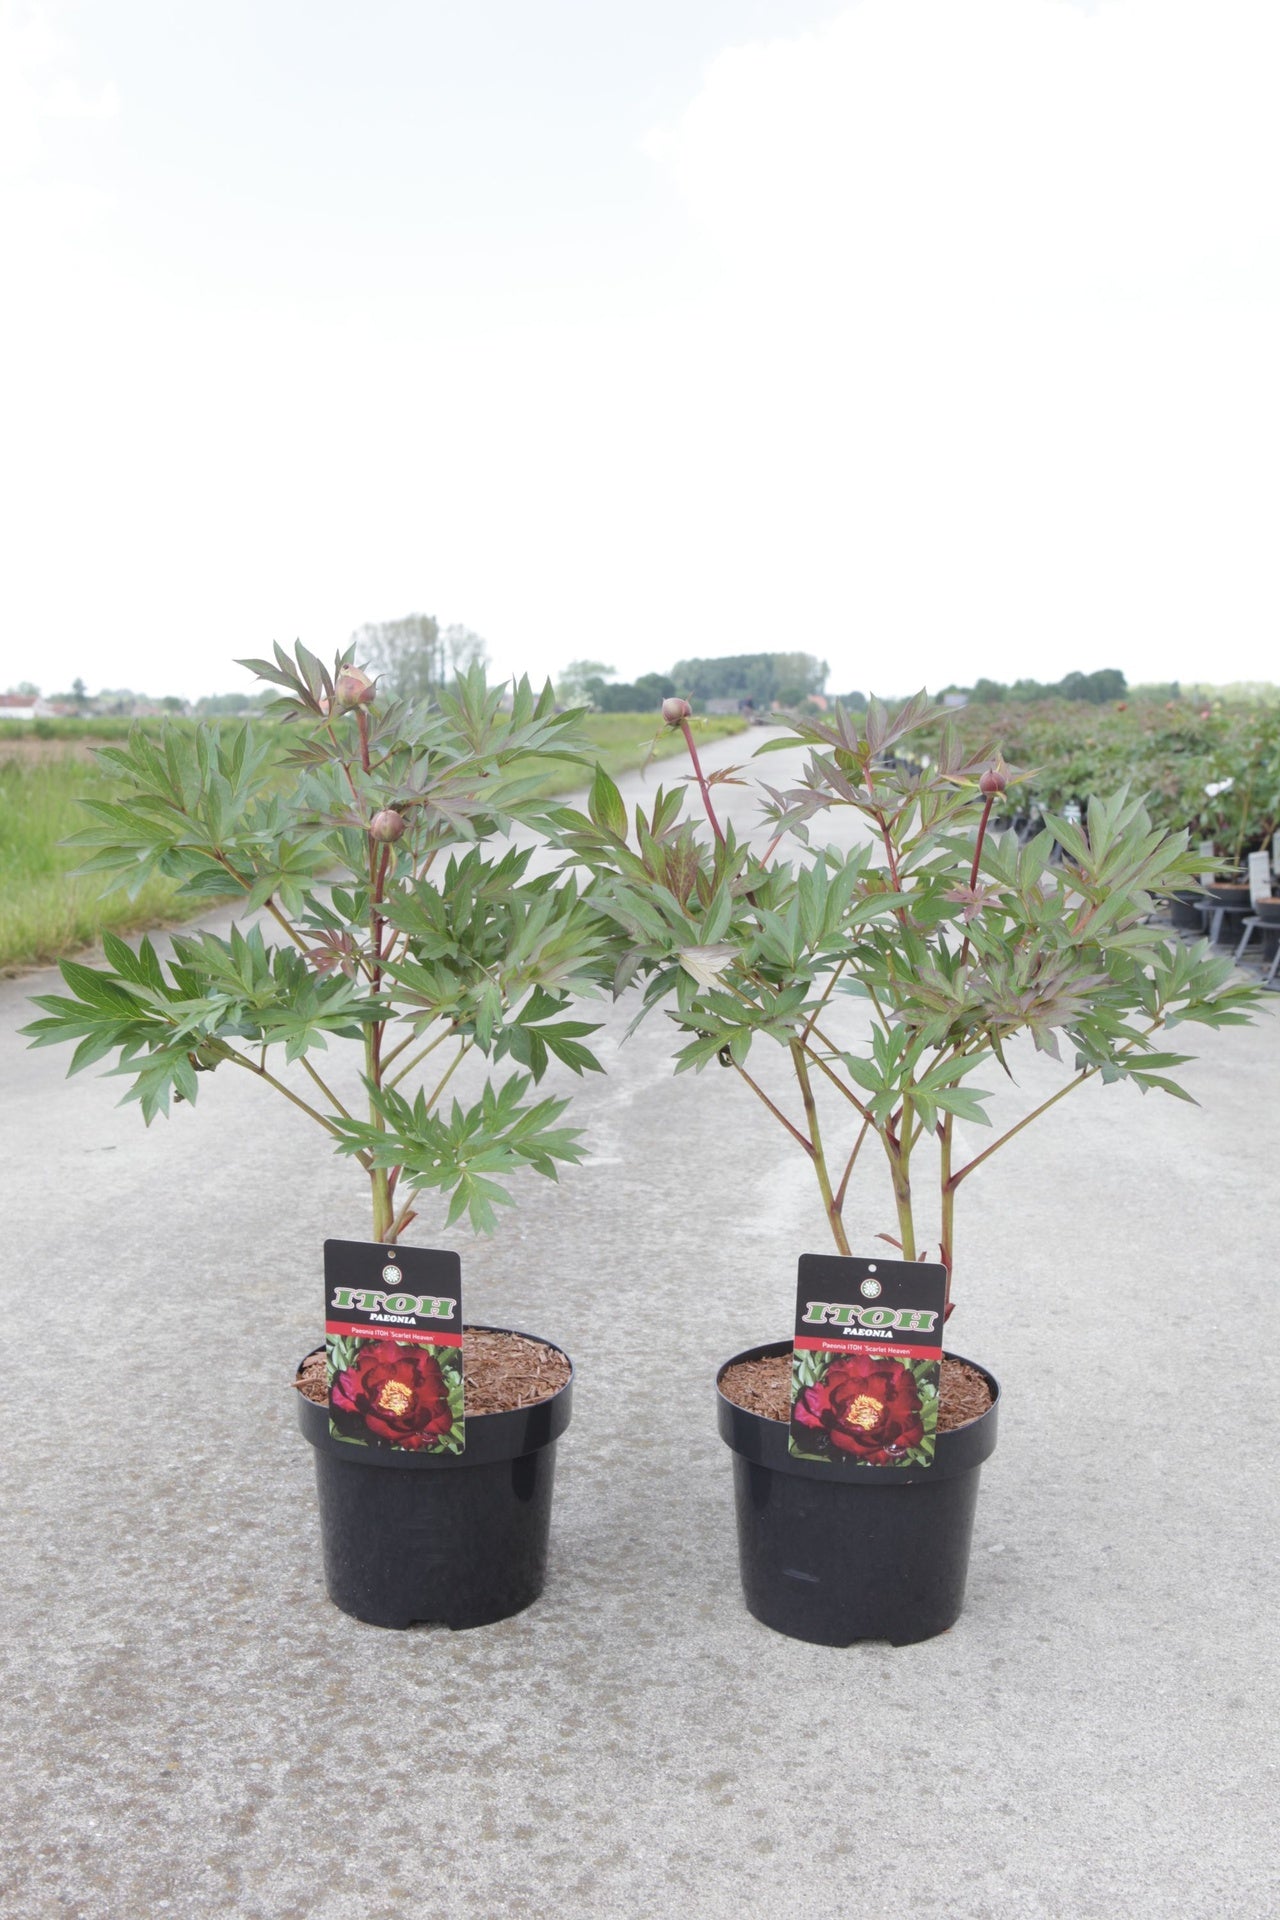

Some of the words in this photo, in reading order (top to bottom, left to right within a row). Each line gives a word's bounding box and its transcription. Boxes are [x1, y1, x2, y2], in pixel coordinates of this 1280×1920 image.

[331, 1287, 457, 1319] ITOH
[369, 1313, 416, 1325] PAEONIA
[802, 1302, 939, 1332] ITOH
[351, 1326, 374, 1336] Paeonia
[374, 1329, 389, 1337] ITOH
[843, 1328, 893, 1338] PAEONIA
[822, 1341, 846, 1350] Paeonia
[847, 1343, 862, 1351] ITOH
